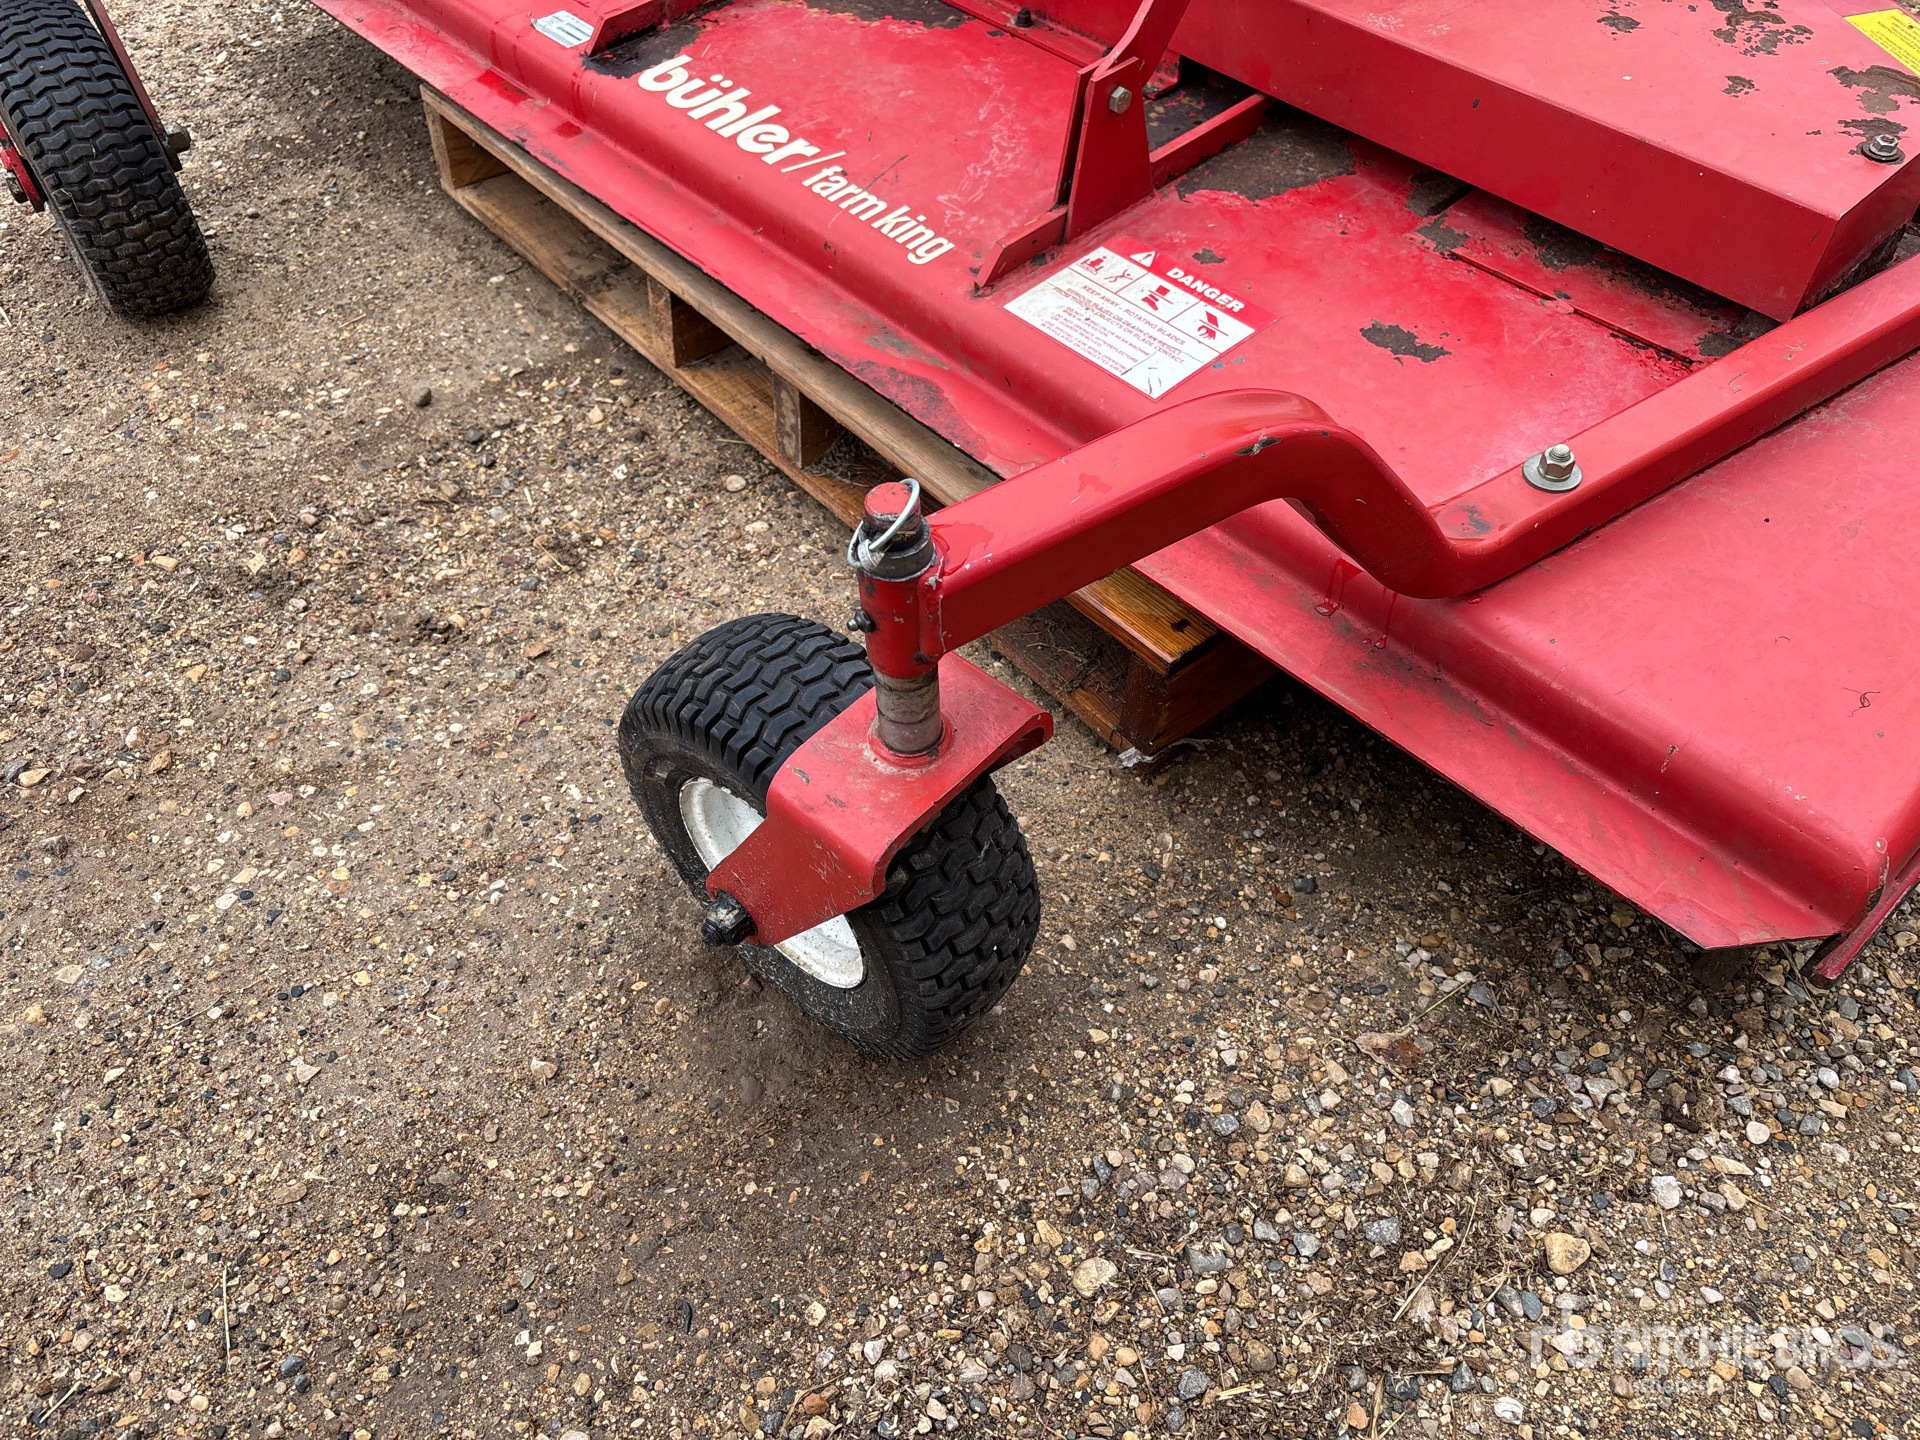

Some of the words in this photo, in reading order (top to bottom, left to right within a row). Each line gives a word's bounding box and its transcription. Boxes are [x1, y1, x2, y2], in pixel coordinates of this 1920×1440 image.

[871, 205, 956, 266] king
[1052, 288, 1071, 298] FROM
[1094, 312, 1124, 329] OBJECTS
[1122, 327, 1134, 335] OR
[1132, 334, 1155, 347] BLADE
[1065, 288, 1093, 304] SERIOUS
[1091, 303, 1114, 316] INJURY
[1122, 321, 1145, 334] DEATH
[1142, 333, 1157, 341] CAN
[1081, 285, 1101, 297] KEEP
[1098, 295, 1120, 307] AWAY
[1123, 309, 1158, 329] ROTATING
[1156, 328, 1186, 345] BLADES
[1166, 267, 1245, 312] DANGER
